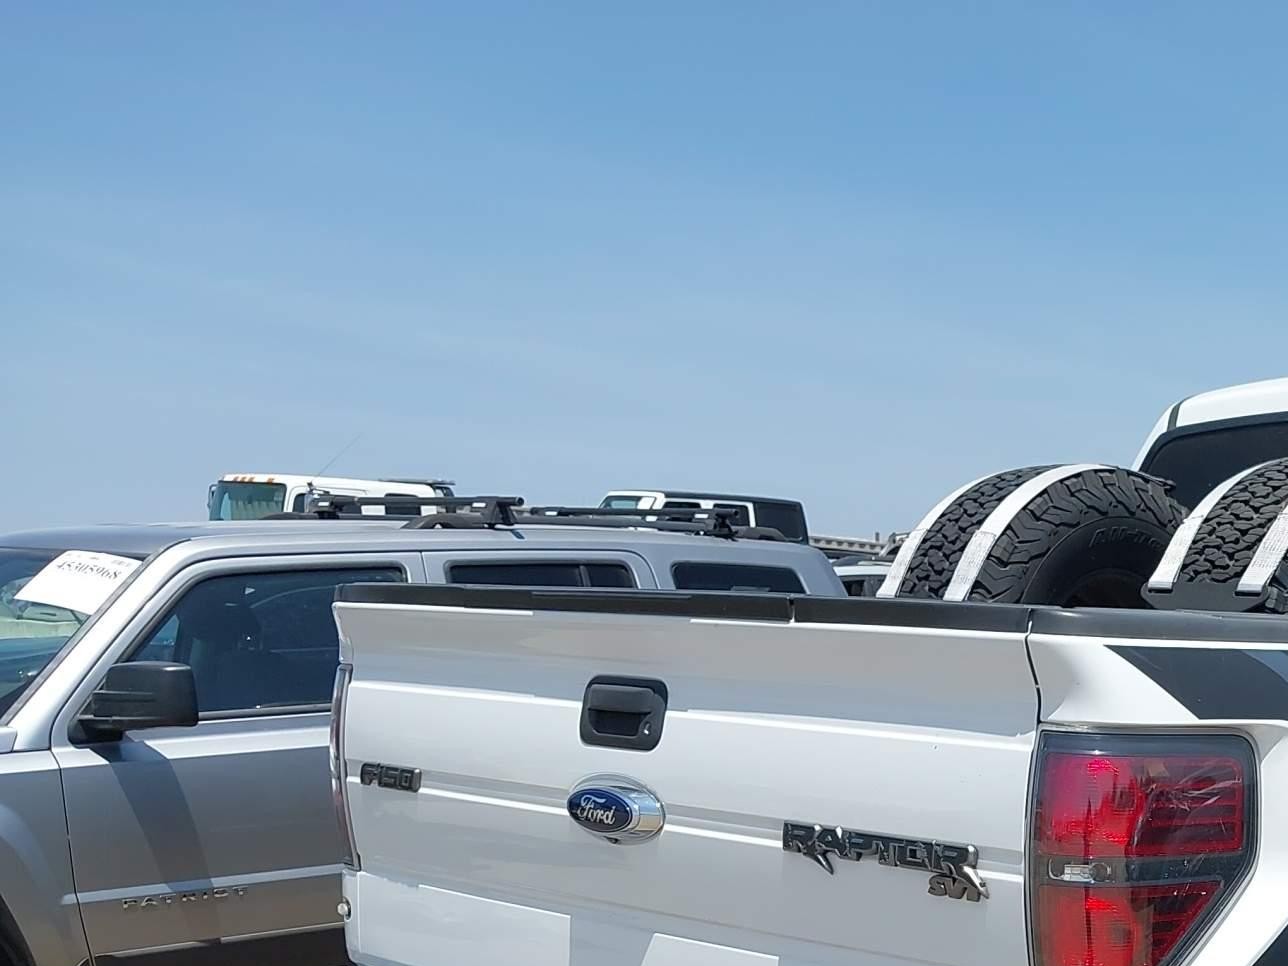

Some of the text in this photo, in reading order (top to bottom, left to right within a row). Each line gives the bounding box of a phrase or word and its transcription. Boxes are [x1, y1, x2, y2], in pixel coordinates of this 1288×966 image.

[577, 795, 616, 825] Ford
[783, 820, 990, 899] RAPTOR
[122, 886, 249, 909] PATRIOT
[928, 873, 982, 903] SVT
